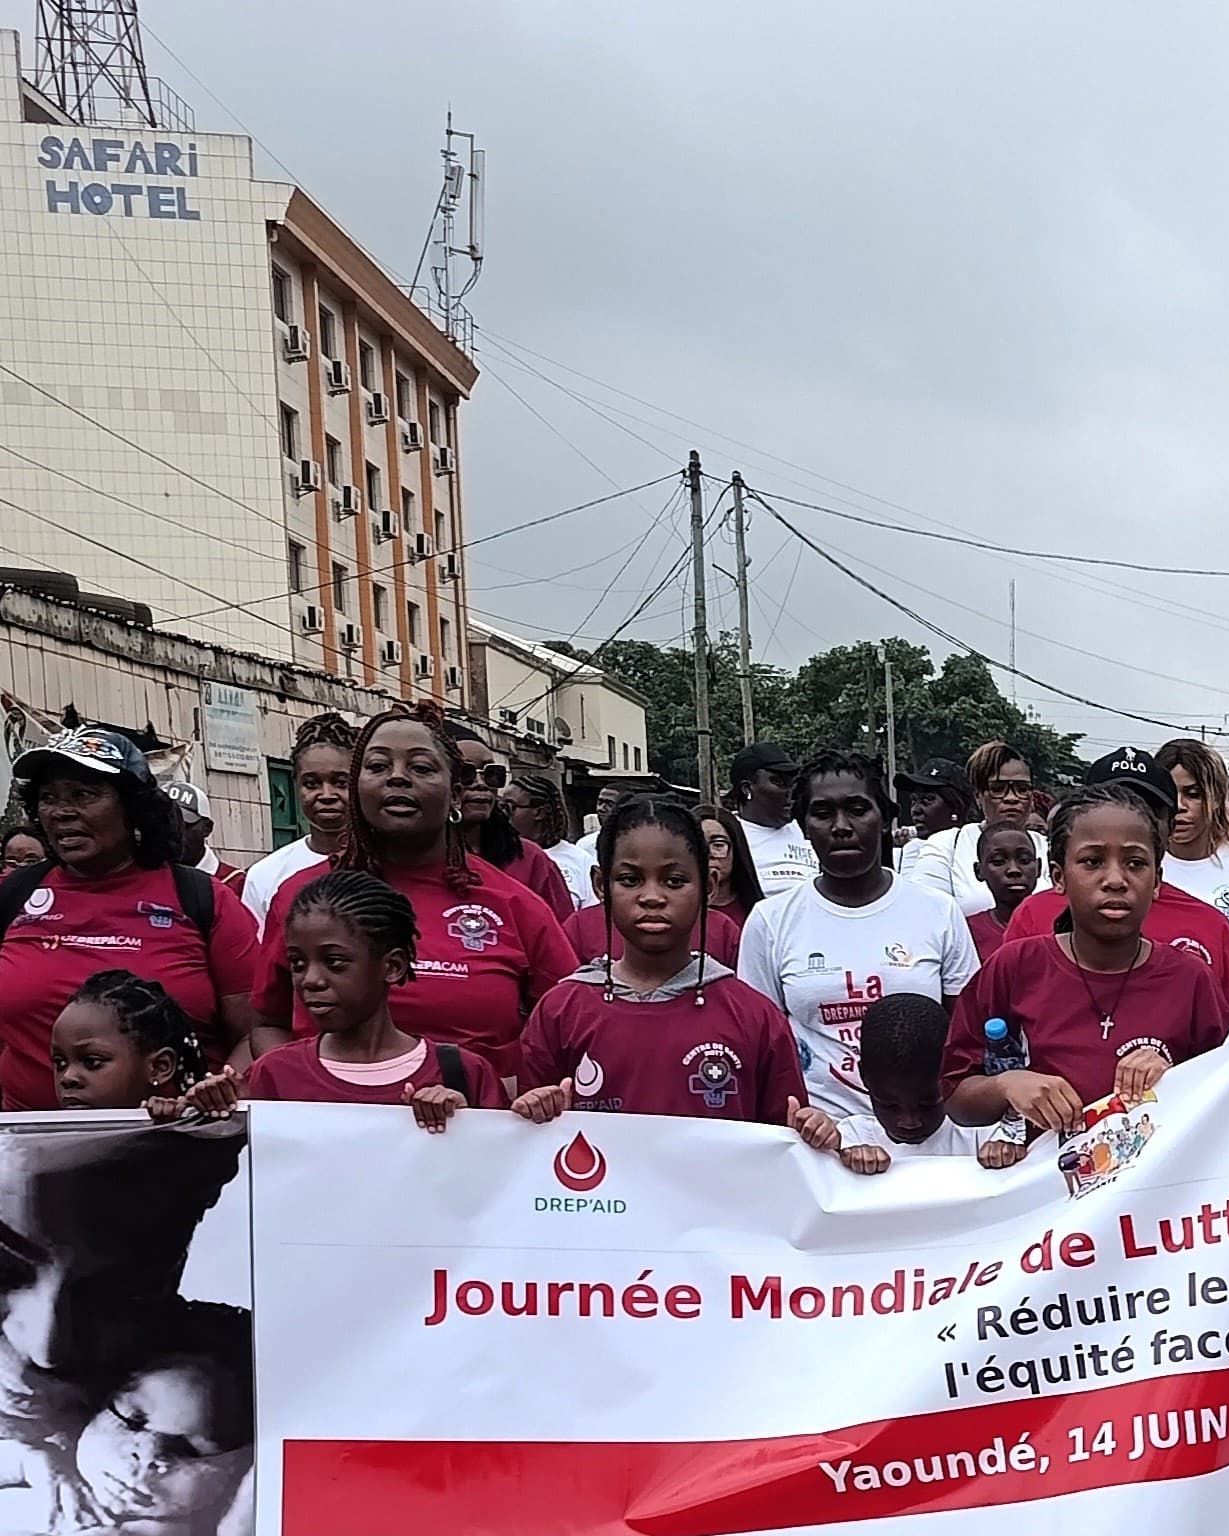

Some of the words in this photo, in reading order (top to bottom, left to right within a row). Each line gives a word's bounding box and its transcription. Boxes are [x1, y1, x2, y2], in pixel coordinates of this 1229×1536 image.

[45, 179, 201, 220] HOTEL
[1111, 760, 1147, 773] POLO
[845, 970, 883, 1000] La
[534, 1197, 628, 1215] DREP'AID
[425, 1268, 703, 1327] Journée
[730, 1258, 1003, 1320] Mondiale
[1020, 1229, 1095, 1275] de
[977, 1285, 1171, 1342] Réduire
[944, 1337, 1136, 1399] l'équité
[819, 1436, 1051, 1494] Yaoundé,
[1068, 1421, 1117, 1463] 14
[1128, 1405, 1228, 1462] JUIN
